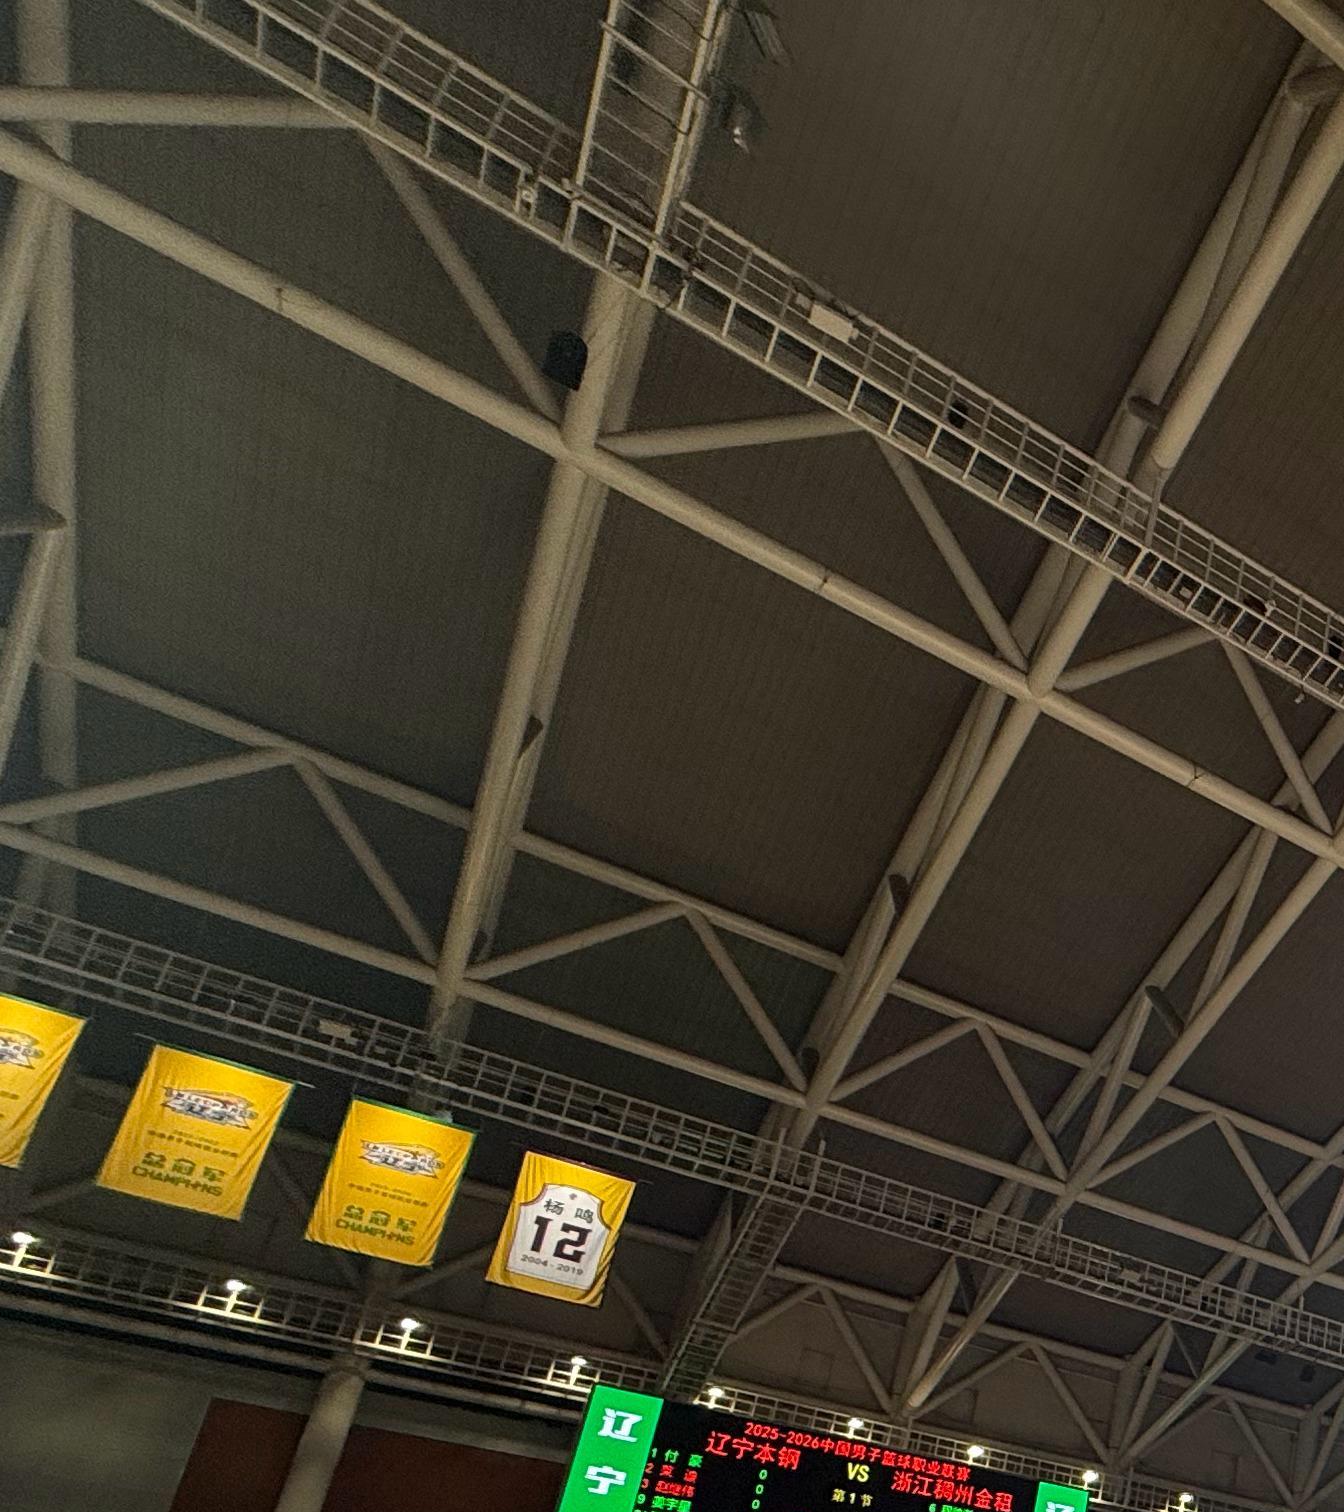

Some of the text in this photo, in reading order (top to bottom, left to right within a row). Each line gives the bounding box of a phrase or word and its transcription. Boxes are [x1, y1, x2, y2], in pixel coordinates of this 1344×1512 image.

[530, 1215, 593, 1264] 12
[704, 1430, 801, 1471] 辽宁本钢
[846, 1462, 871, 1483] VS
